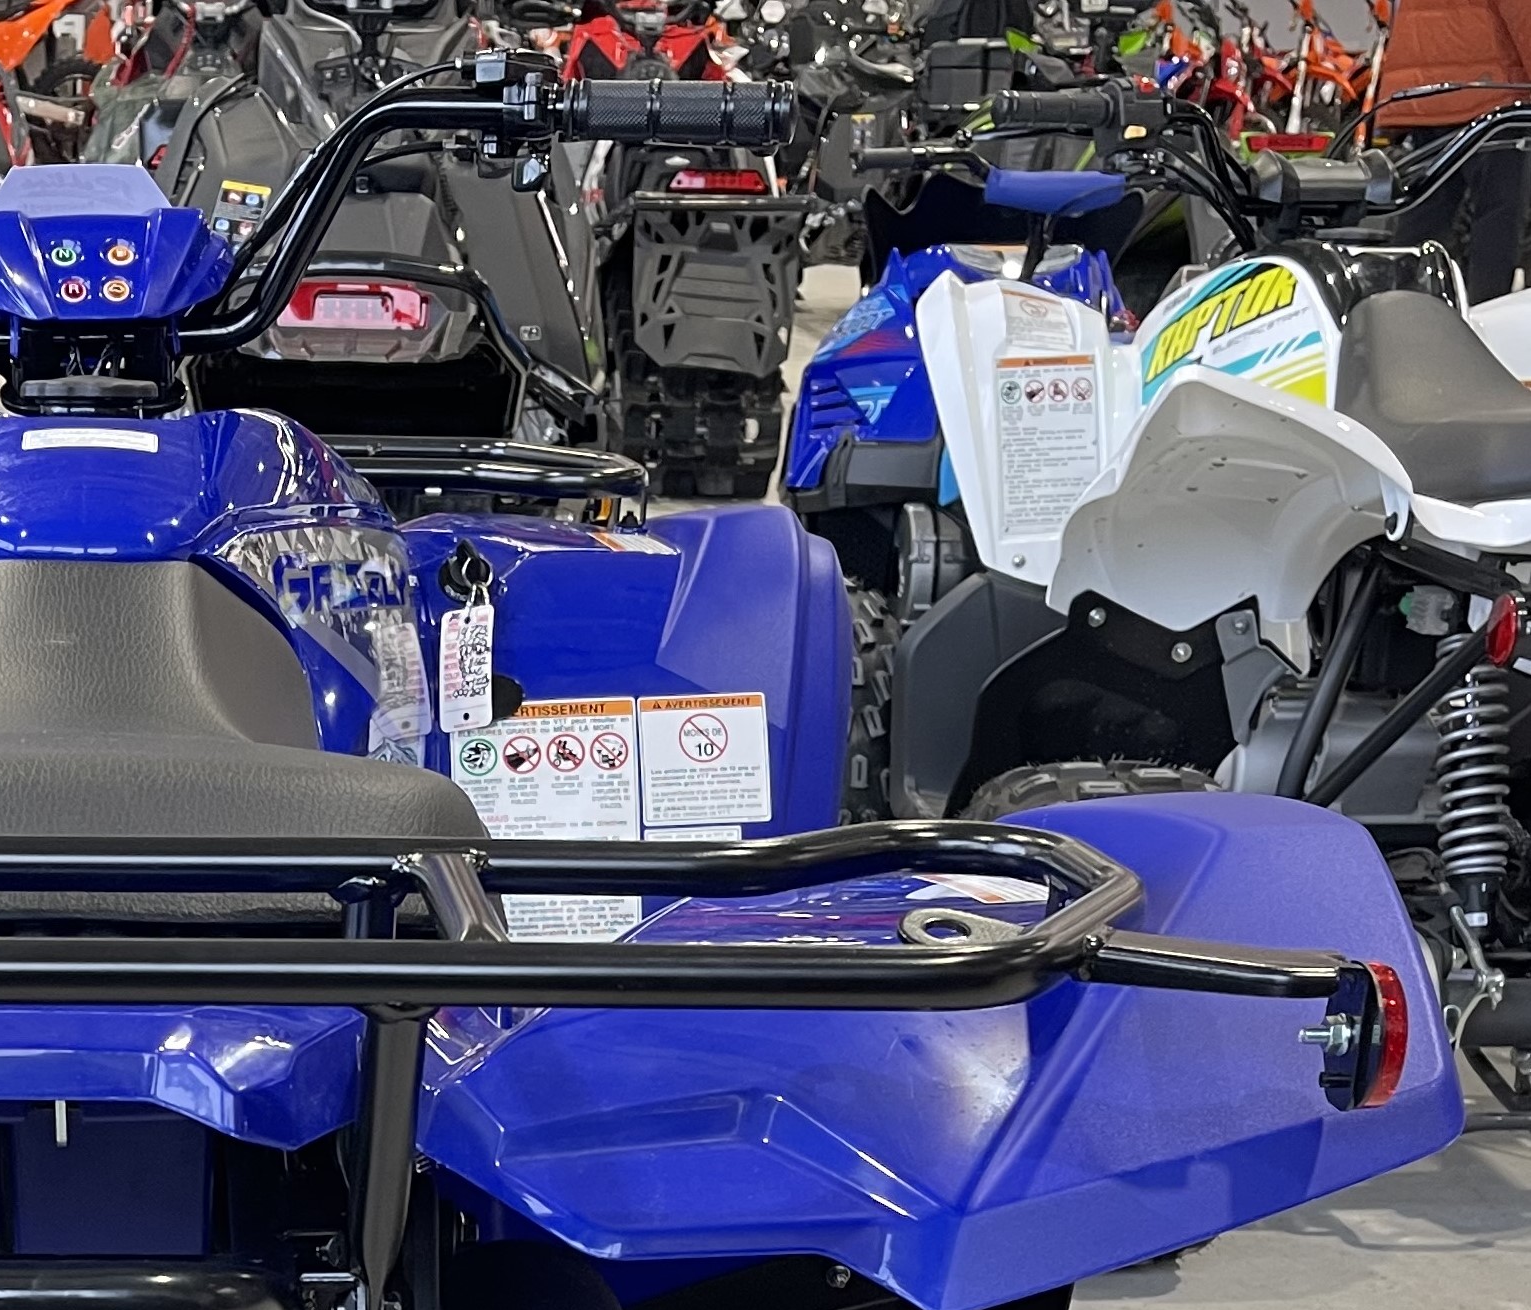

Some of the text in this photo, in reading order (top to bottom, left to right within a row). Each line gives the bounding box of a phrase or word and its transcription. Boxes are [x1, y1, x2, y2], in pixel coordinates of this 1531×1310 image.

[58, 248, 69, 258] N
[67, 283, 80, 295] R
[1145, 265, 1299, 384] RAPTOR
[665, 697, 751, 709] AVERTISSEMENT
[513, 703, 606, 717] ERTISSEMENT
[712, 727, 723, 736] DE
[695, 743, 714, 757] 10
